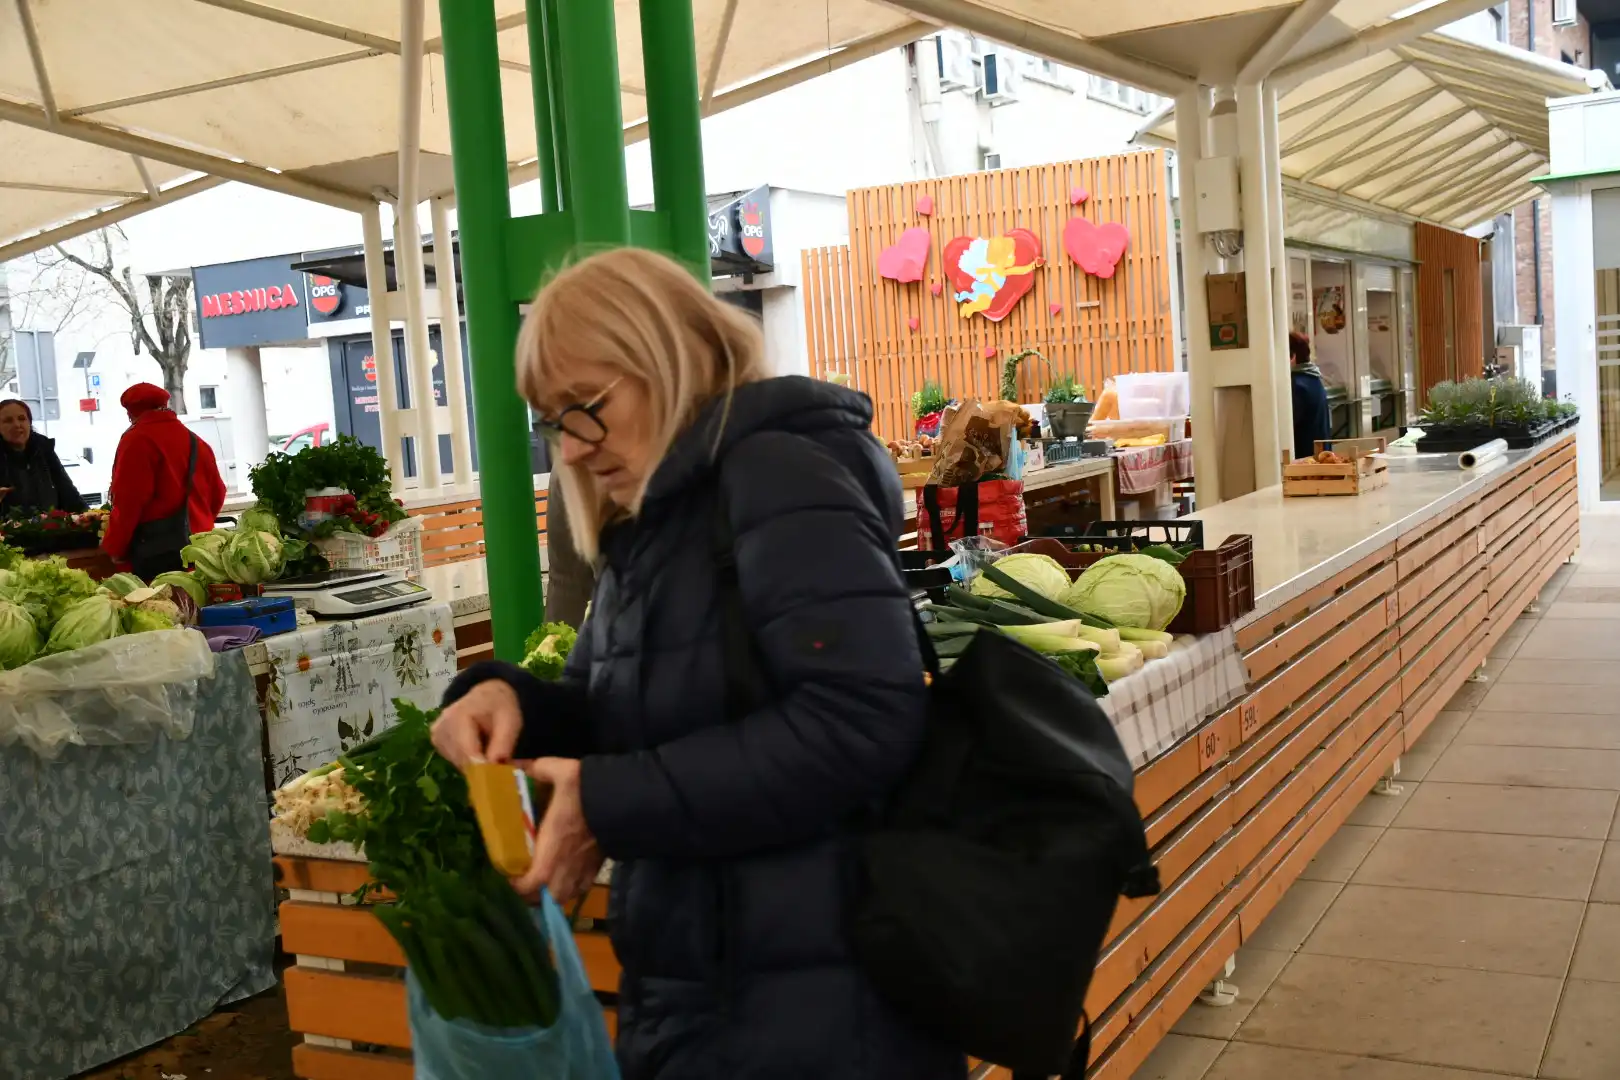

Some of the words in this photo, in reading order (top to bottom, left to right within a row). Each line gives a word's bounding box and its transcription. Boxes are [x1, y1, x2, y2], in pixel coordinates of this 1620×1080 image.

[744, 225, 763, 237] OPG
[312, 285, 336, 297] OPG
[202, 284, 299, 318] MESNICA
[1205, 732, 1216, 759] 60
